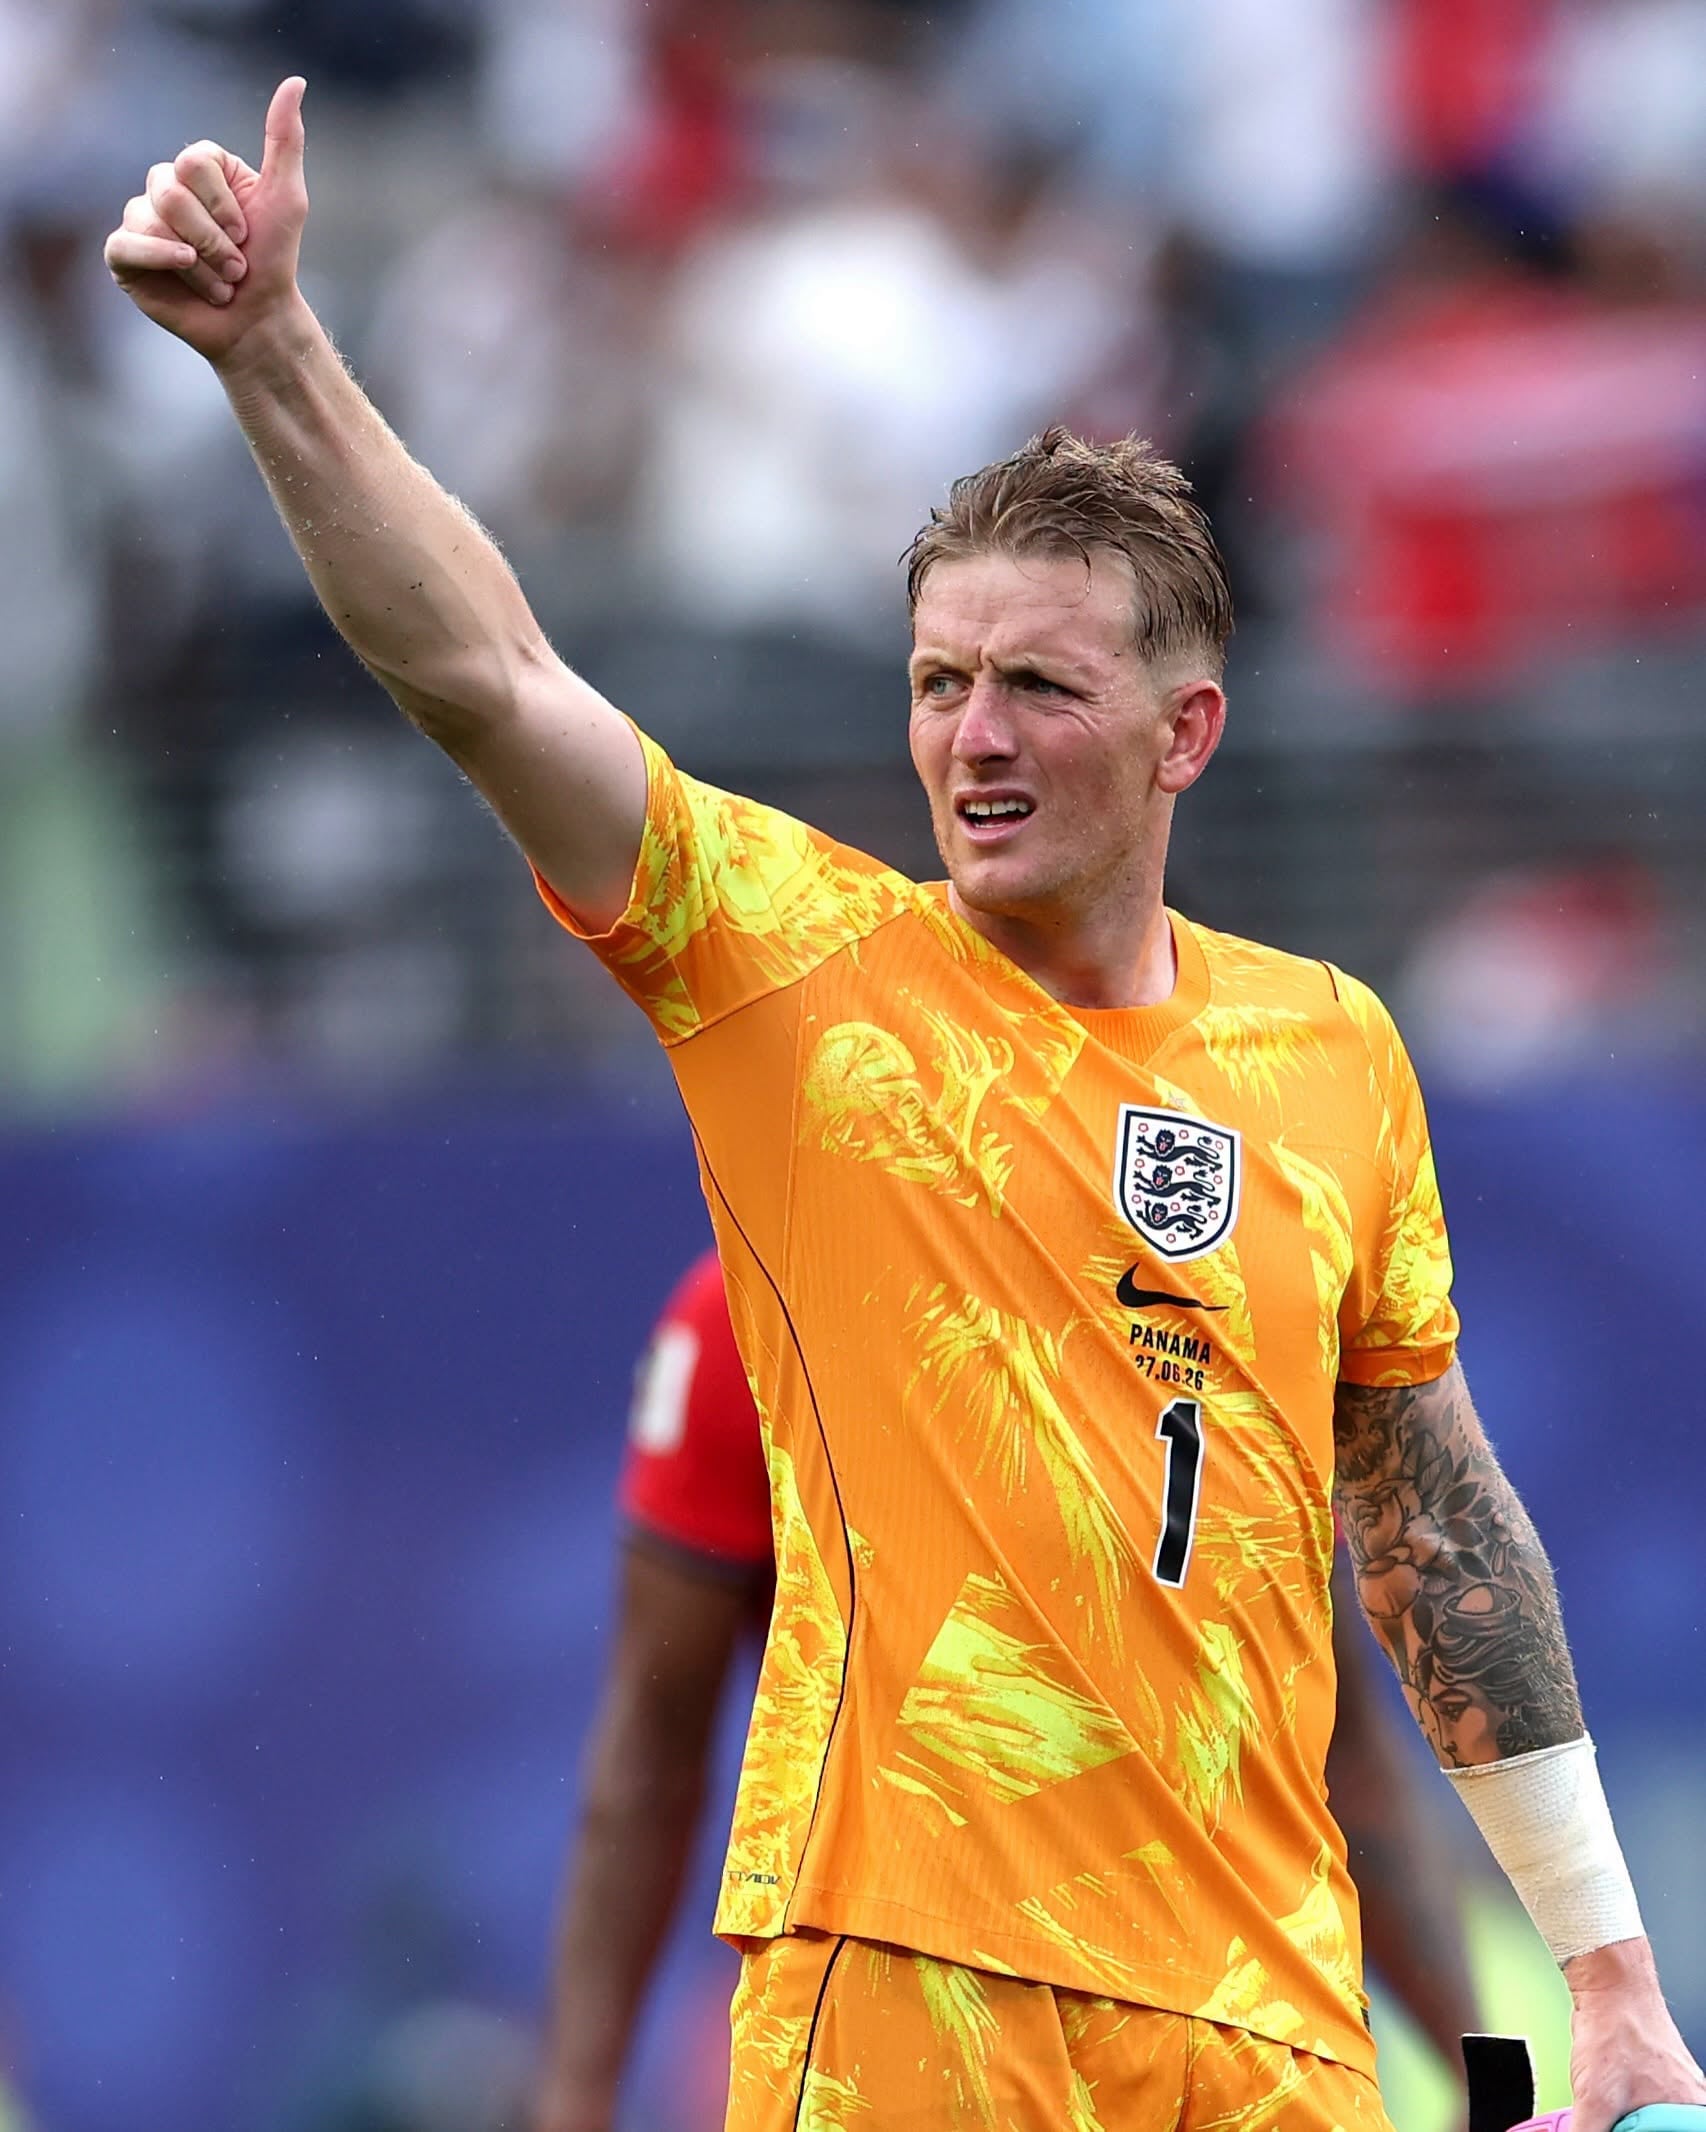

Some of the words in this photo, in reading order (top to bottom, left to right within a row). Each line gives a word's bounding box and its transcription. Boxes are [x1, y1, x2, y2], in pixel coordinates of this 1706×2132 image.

[1130, 1323, 1211, 1365] PANAMA
[1135, 1354, 1204, 1391] 27.06.26
[1153, 1398, 1204, 1588] 1
